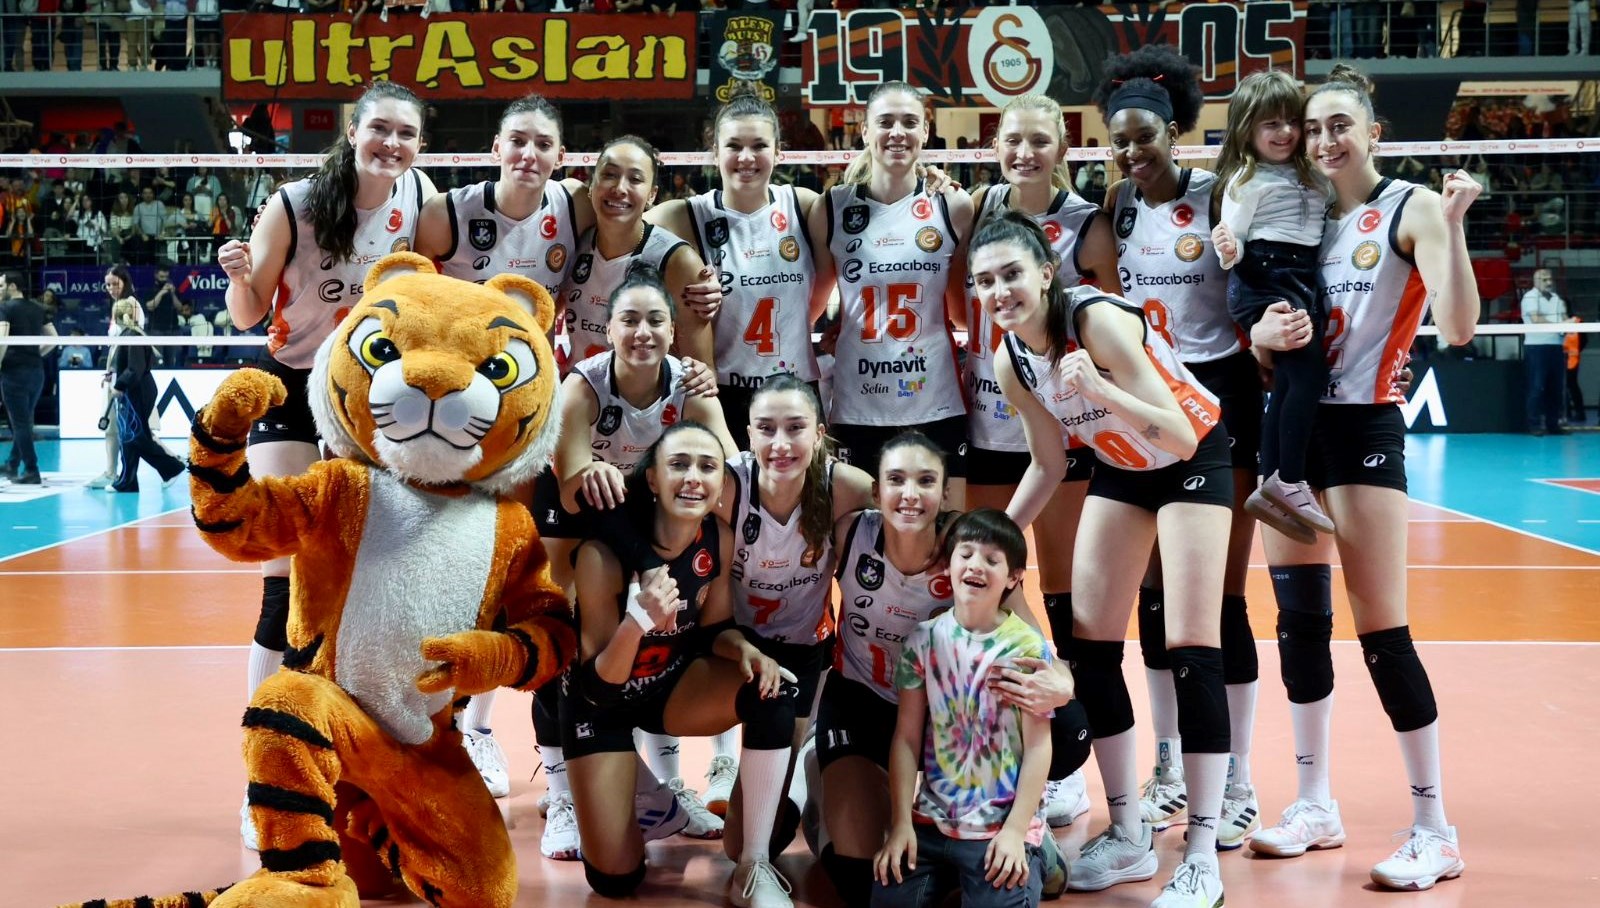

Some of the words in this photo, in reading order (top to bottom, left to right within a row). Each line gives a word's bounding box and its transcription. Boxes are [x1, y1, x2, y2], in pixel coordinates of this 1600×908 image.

[229, 20, 687, 87] ultrAslan
[807, 8, 907, 105] 19
[1178, 1, 1297, 100] 05
[1001, 58, 1021, 68] 1905
[869, 259, 941, 274] Eczacıbaşı
[741, 271, 804, 287] Eczacıbaşı
[1136, 272, 1205, 288] Eczacıbaşı
[860, 283, 924, 344] 15
[743, 297, 781, 357] 4
[858, 356, 927, 379] Dynavit
[861, 382, 890, 395] Selin
[747, 594, 789, 626] 7
[826, 728, 851, 750] 11
